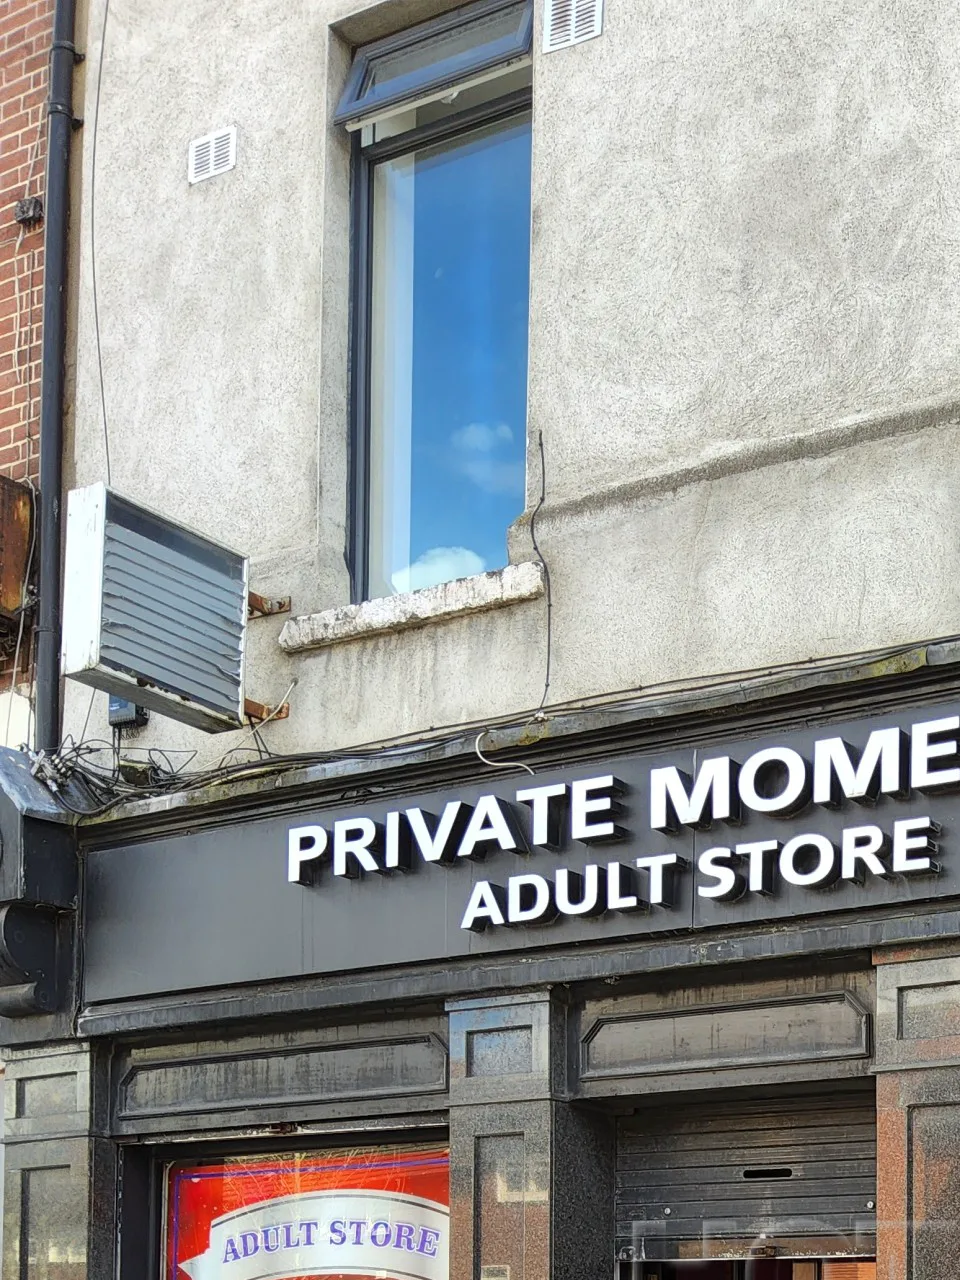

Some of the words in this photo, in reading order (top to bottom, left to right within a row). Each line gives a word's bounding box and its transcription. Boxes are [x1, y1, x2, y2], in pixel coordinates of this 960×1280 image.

[287, 774, 622, 885] PRIVATE
[461, 852, 680, 932] ADULT
[697, 816, 938, 903] STORE
[222, 1221, 319, 1264] ADULT
[329, 1219, 442, 1258] STORE
